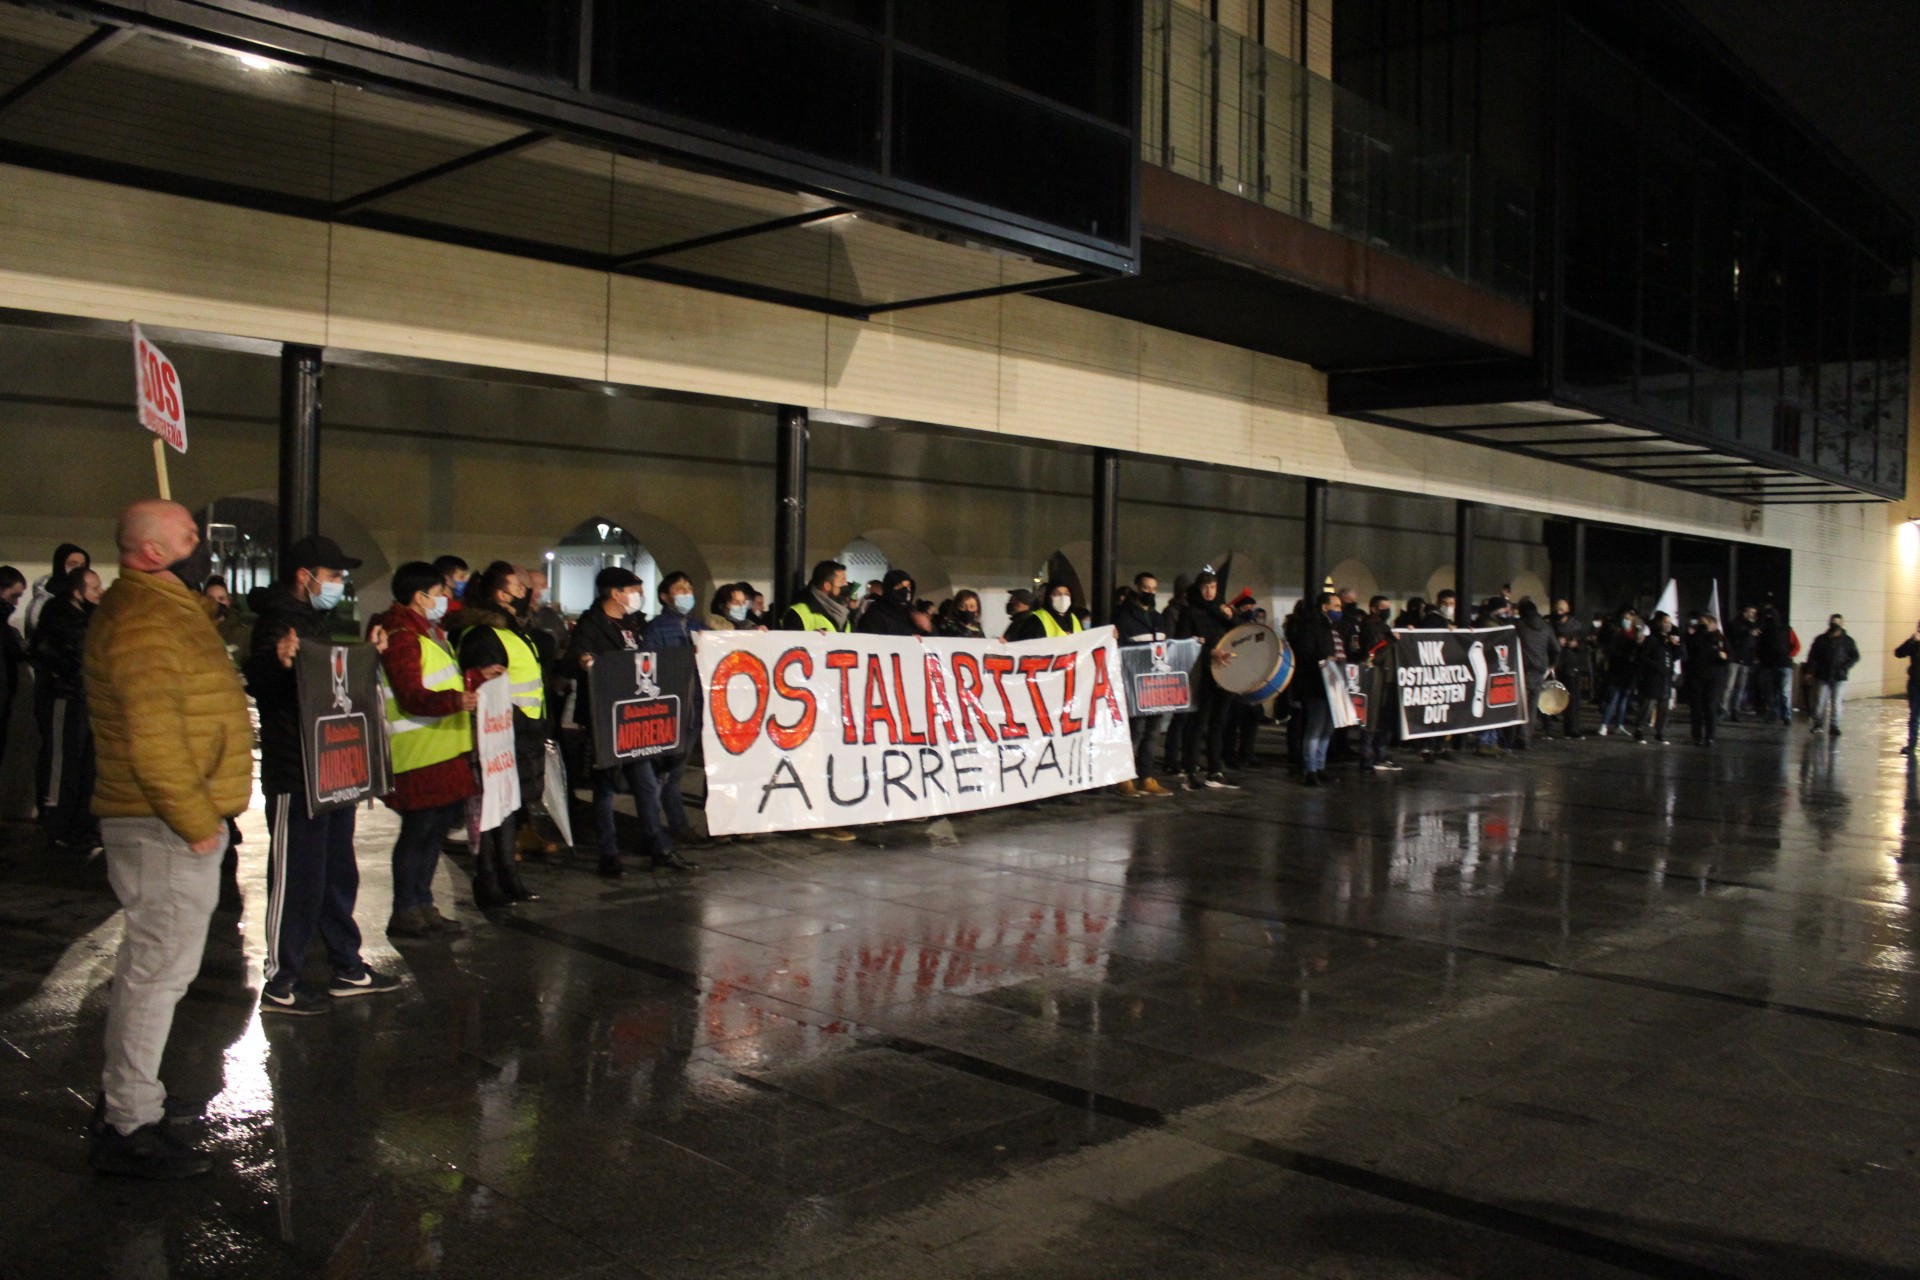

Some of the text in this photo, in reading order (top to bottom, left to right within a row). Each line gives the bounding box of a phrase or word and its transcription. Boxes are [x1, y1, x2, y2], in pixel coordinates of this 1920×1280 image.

[139, 340, 180, 421] SOS
[1417, 641, 1446, 666] NIK
[1397, 664, 1475, 687] OSTALARITZA
[710, 646, 1124, 755] OSTALARITZA
[1403, 683, 1467, 707] BABESTEN
[1423, 704, 1450, 725] DUT
[758, 739, 1096, 814] AURRERA!!!
